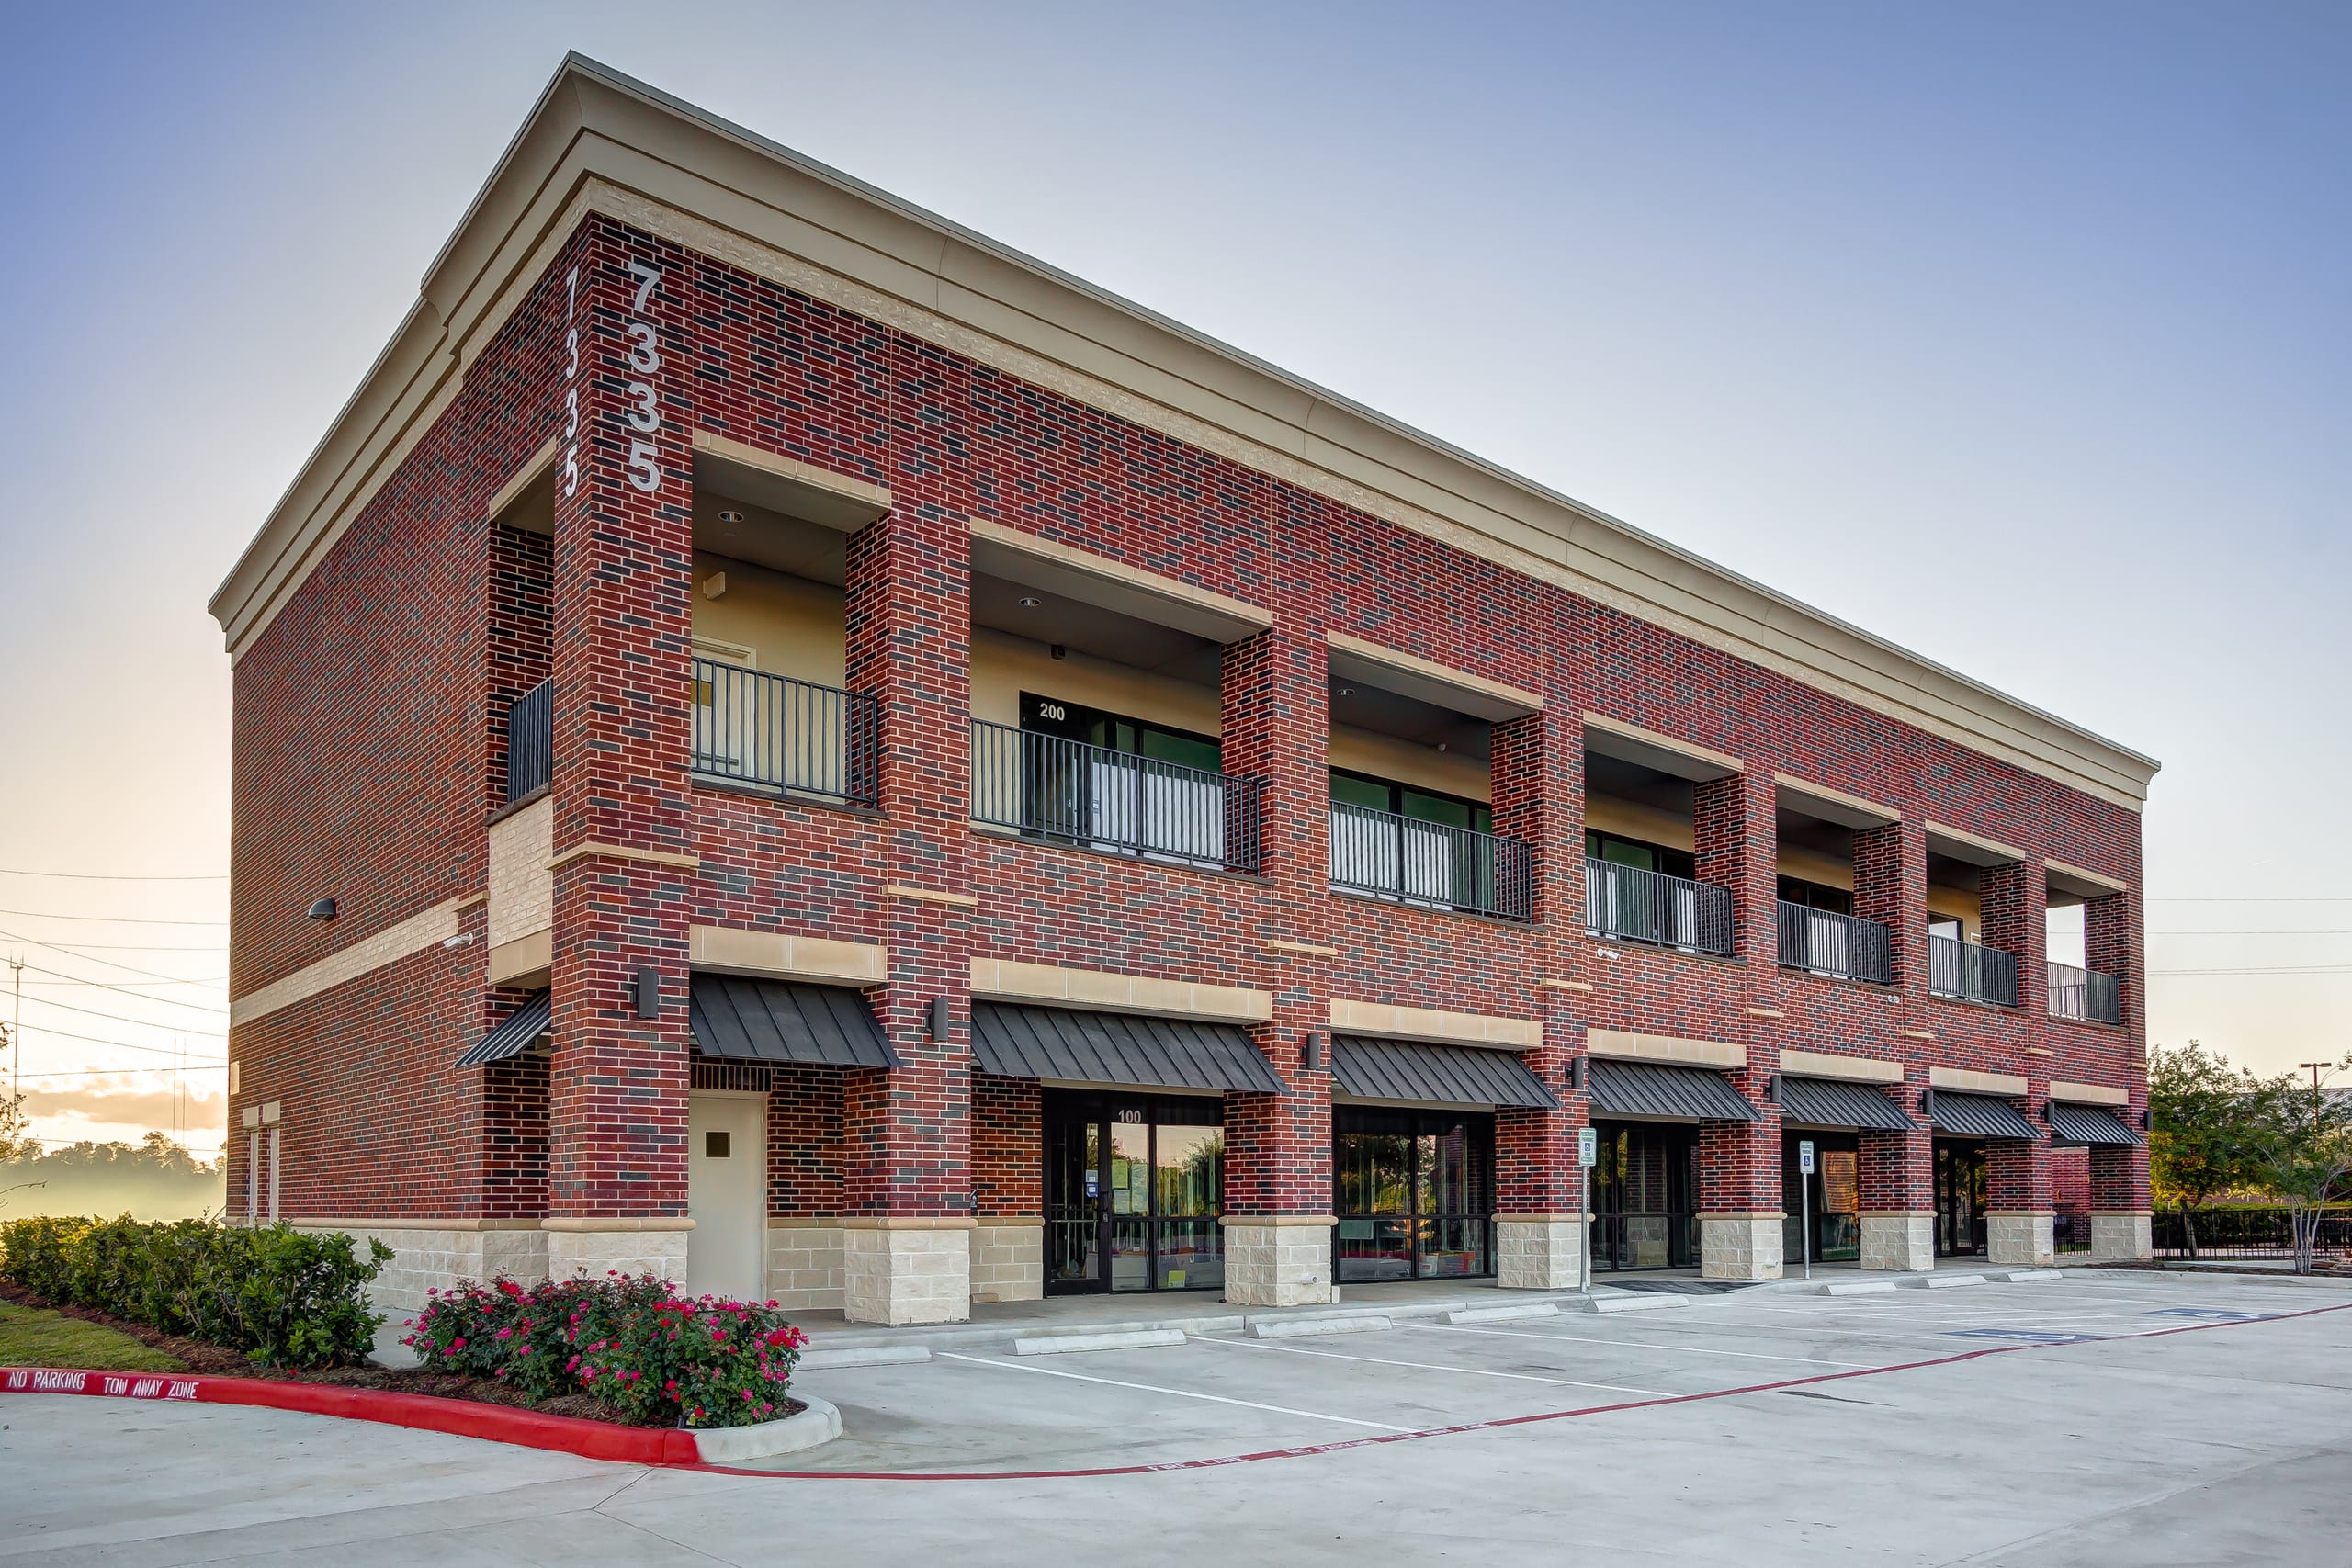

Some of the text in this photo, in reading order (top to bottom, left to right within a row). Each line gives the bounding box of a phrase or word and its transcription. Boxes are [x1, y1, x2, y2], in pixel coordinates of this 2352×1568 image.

[627, 261, 661, 492] 7335
[1039, 702, 1066, 721] 200
[1118, 1109, 1142, 1124] 100
[7, 1371, 200, 1399] NO PARKING TOW AWAY ZONE
